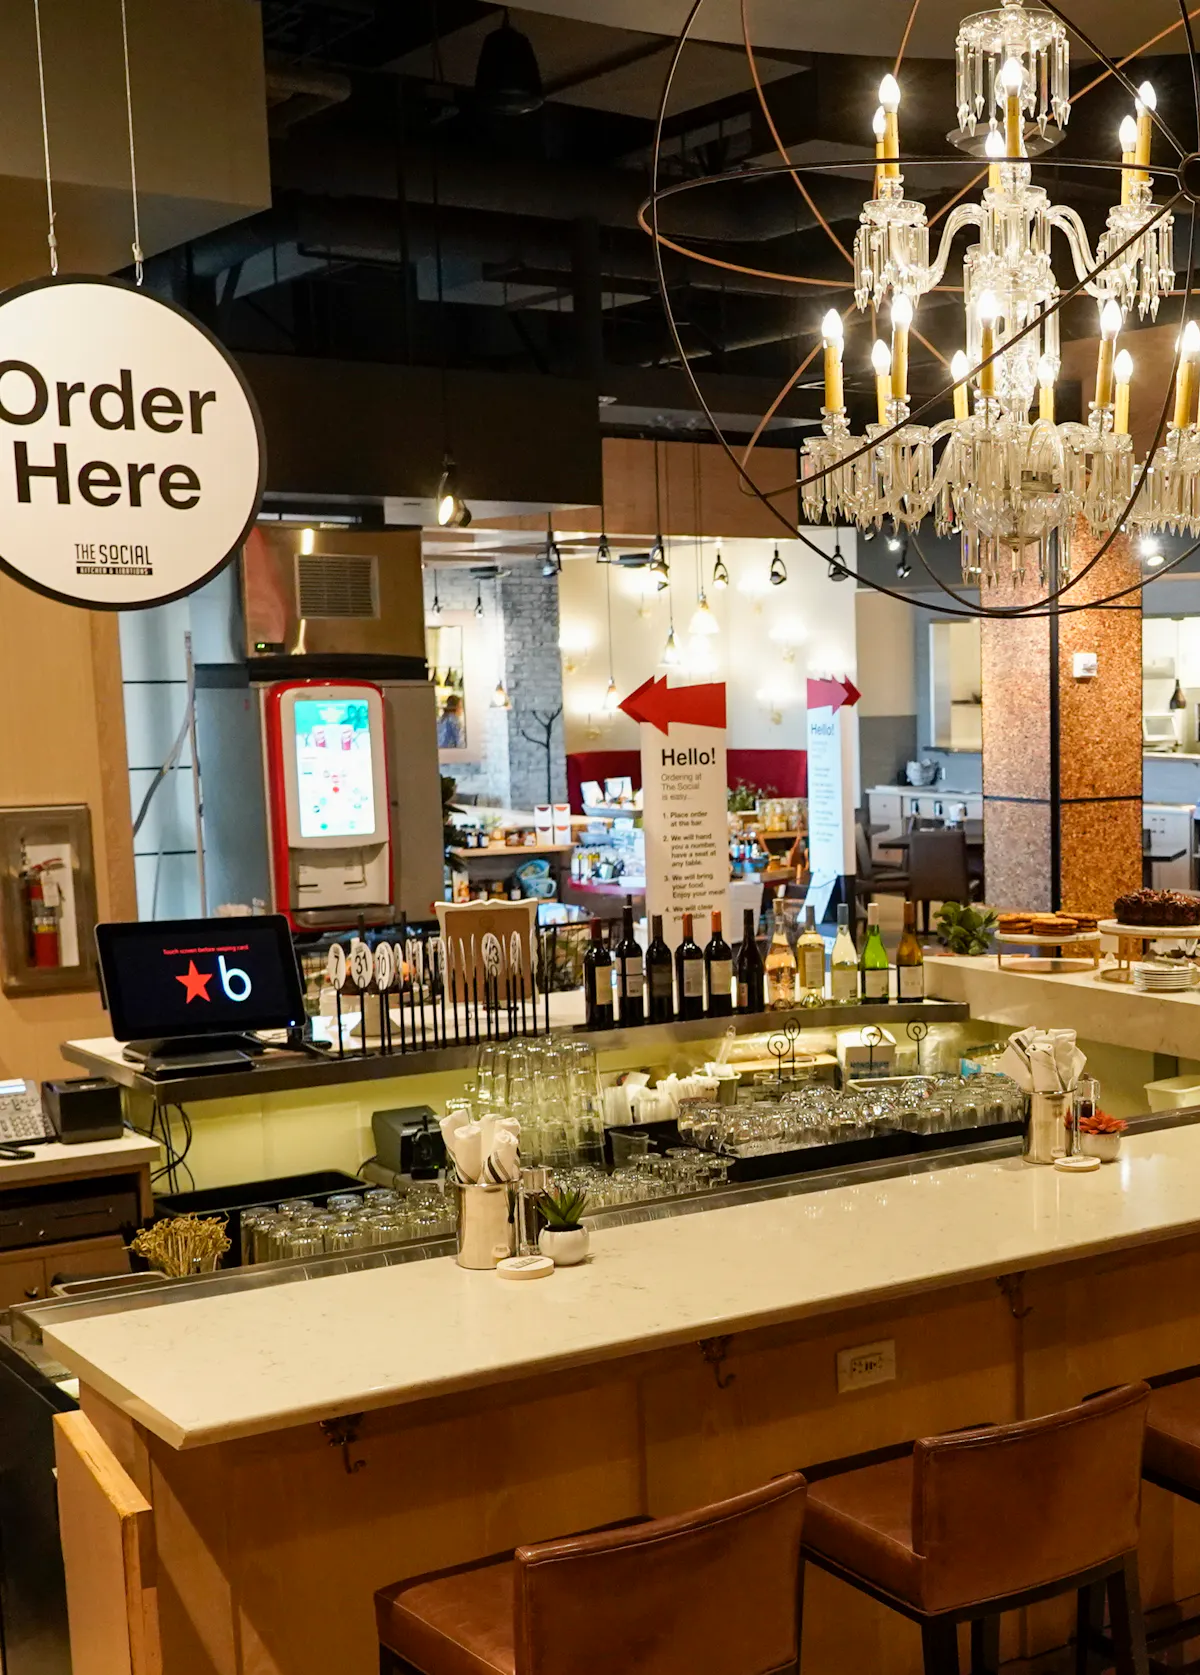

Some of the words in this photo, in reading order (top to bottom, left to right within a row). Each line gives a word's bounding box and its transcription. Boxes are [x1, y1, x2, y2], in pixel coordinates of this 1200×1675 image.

[0, 360, 216, 434] Order
[13, 441, 201, 510] Here
[75, 543, 96, 560] THE
[99, 544, 153, 565] SOCIAL
[661, 747, 716, 766] Hello!
[677, 782, 699, 791] Social
[673, 891, 691, 899] Enjoy
[334, 954, 340, 975] 7
[354, 951, 369, 975] 31
[377, 953, 387, 976] 10
[218, 954, 252, 1002] b
